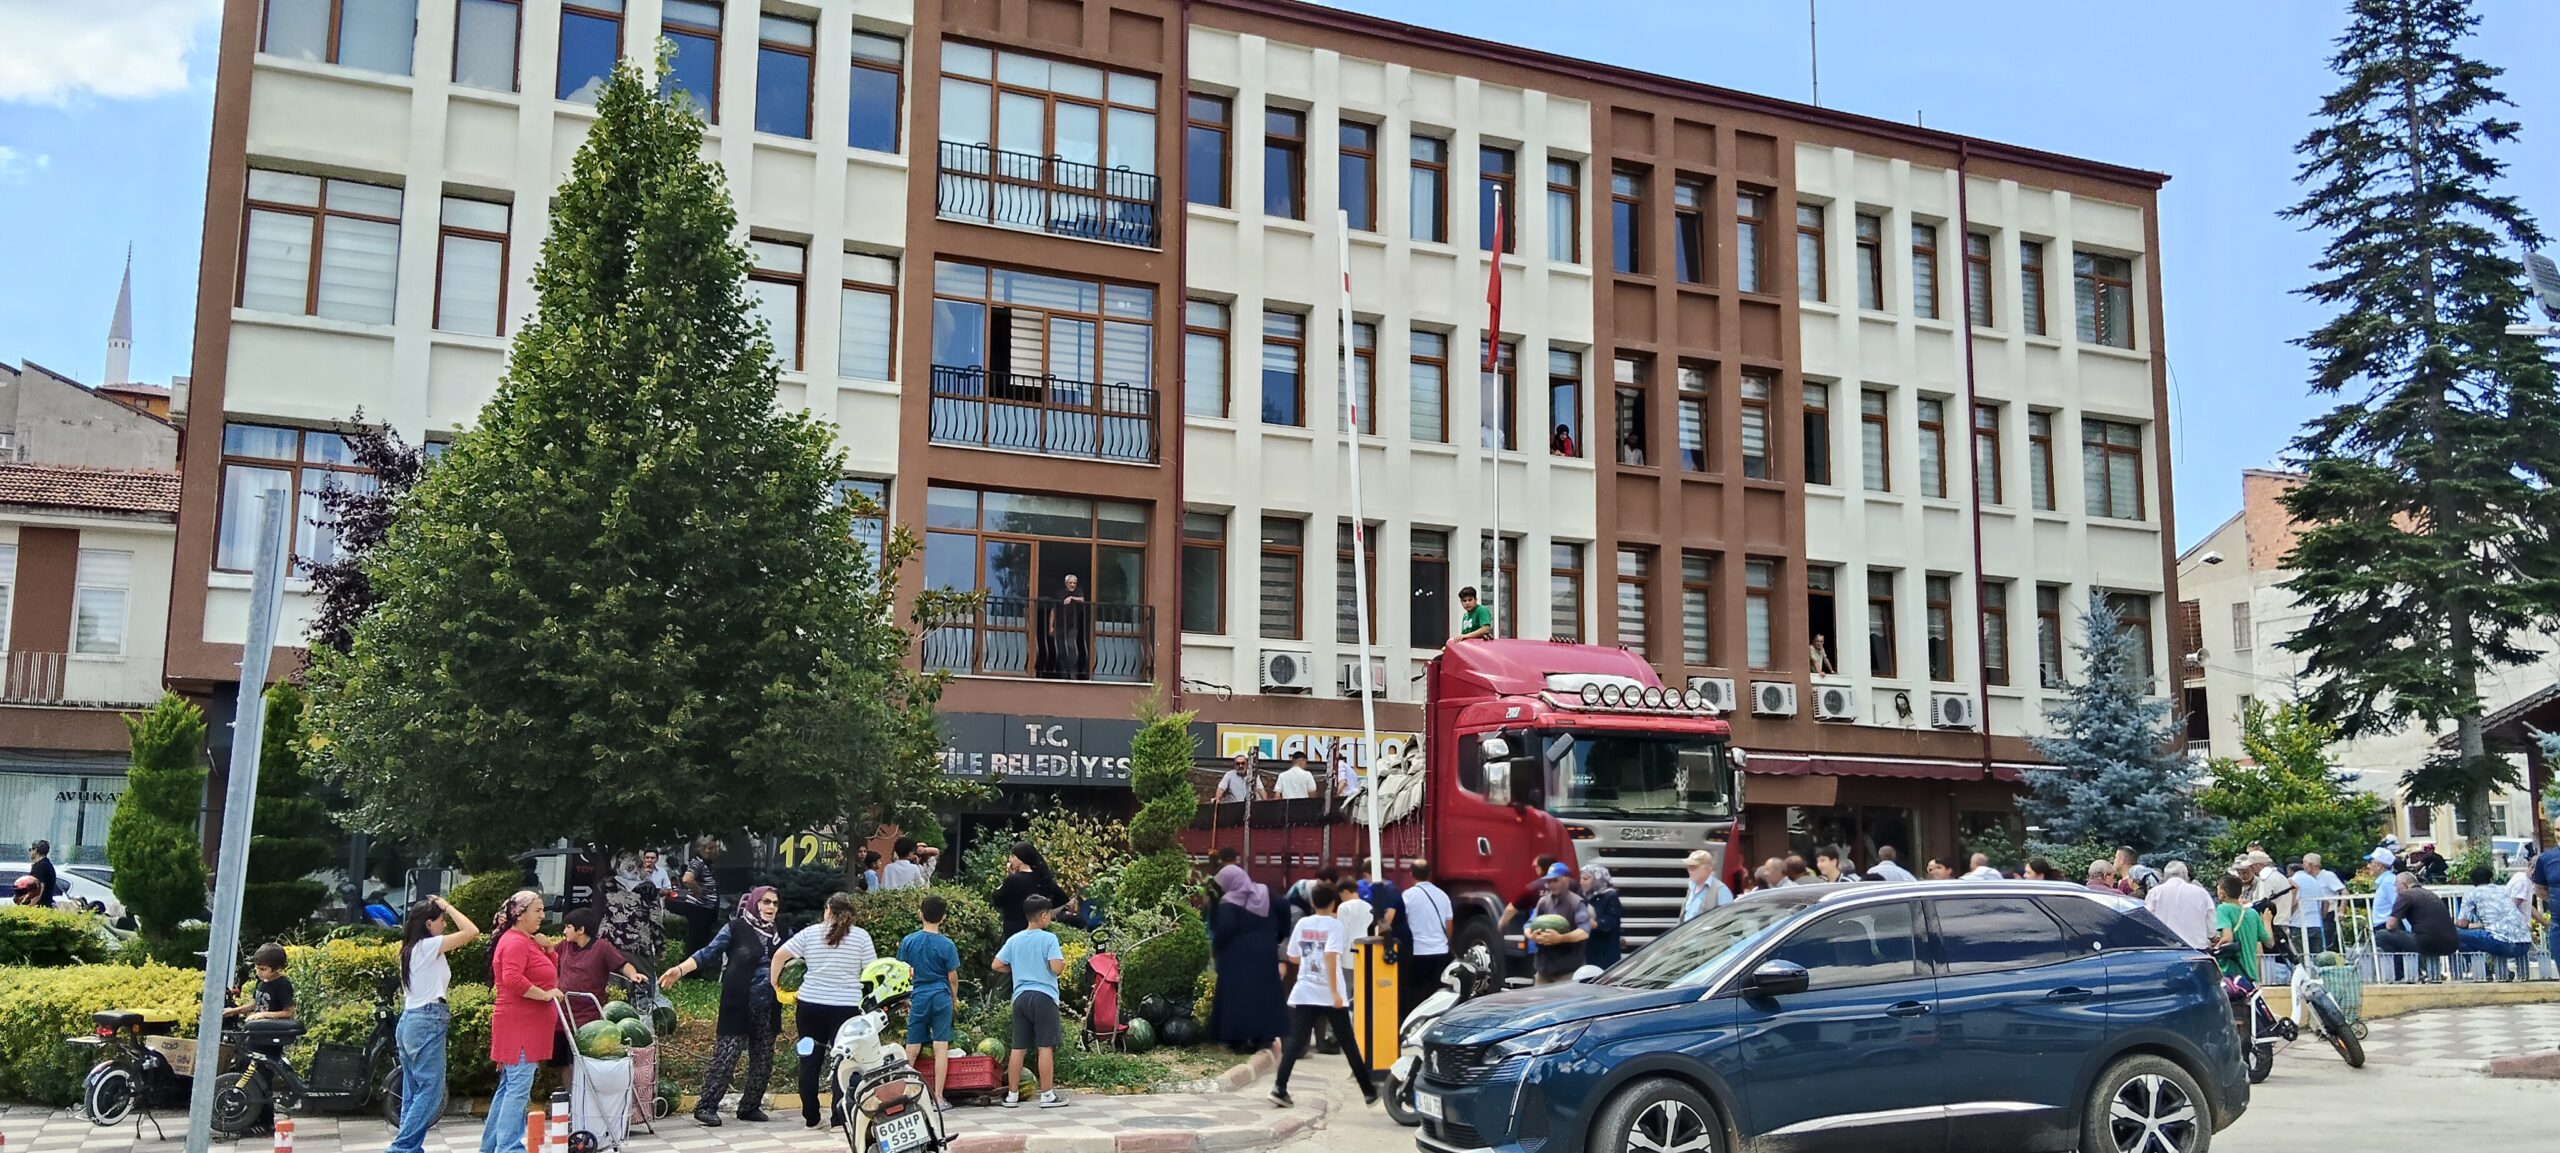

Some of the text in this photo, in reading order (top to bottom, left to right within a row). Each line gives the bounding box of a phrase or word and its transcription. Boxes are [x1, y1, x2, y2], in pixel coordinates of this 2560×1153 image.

[1025, 724, 1069, 747] T.C.
[991, 750, 1132, 779] BELEDİYES
[1280, 734, 1405, 768] ANADO
[779, 834, 819, 868] 12
[891, 1128, 917, 1146] 595
